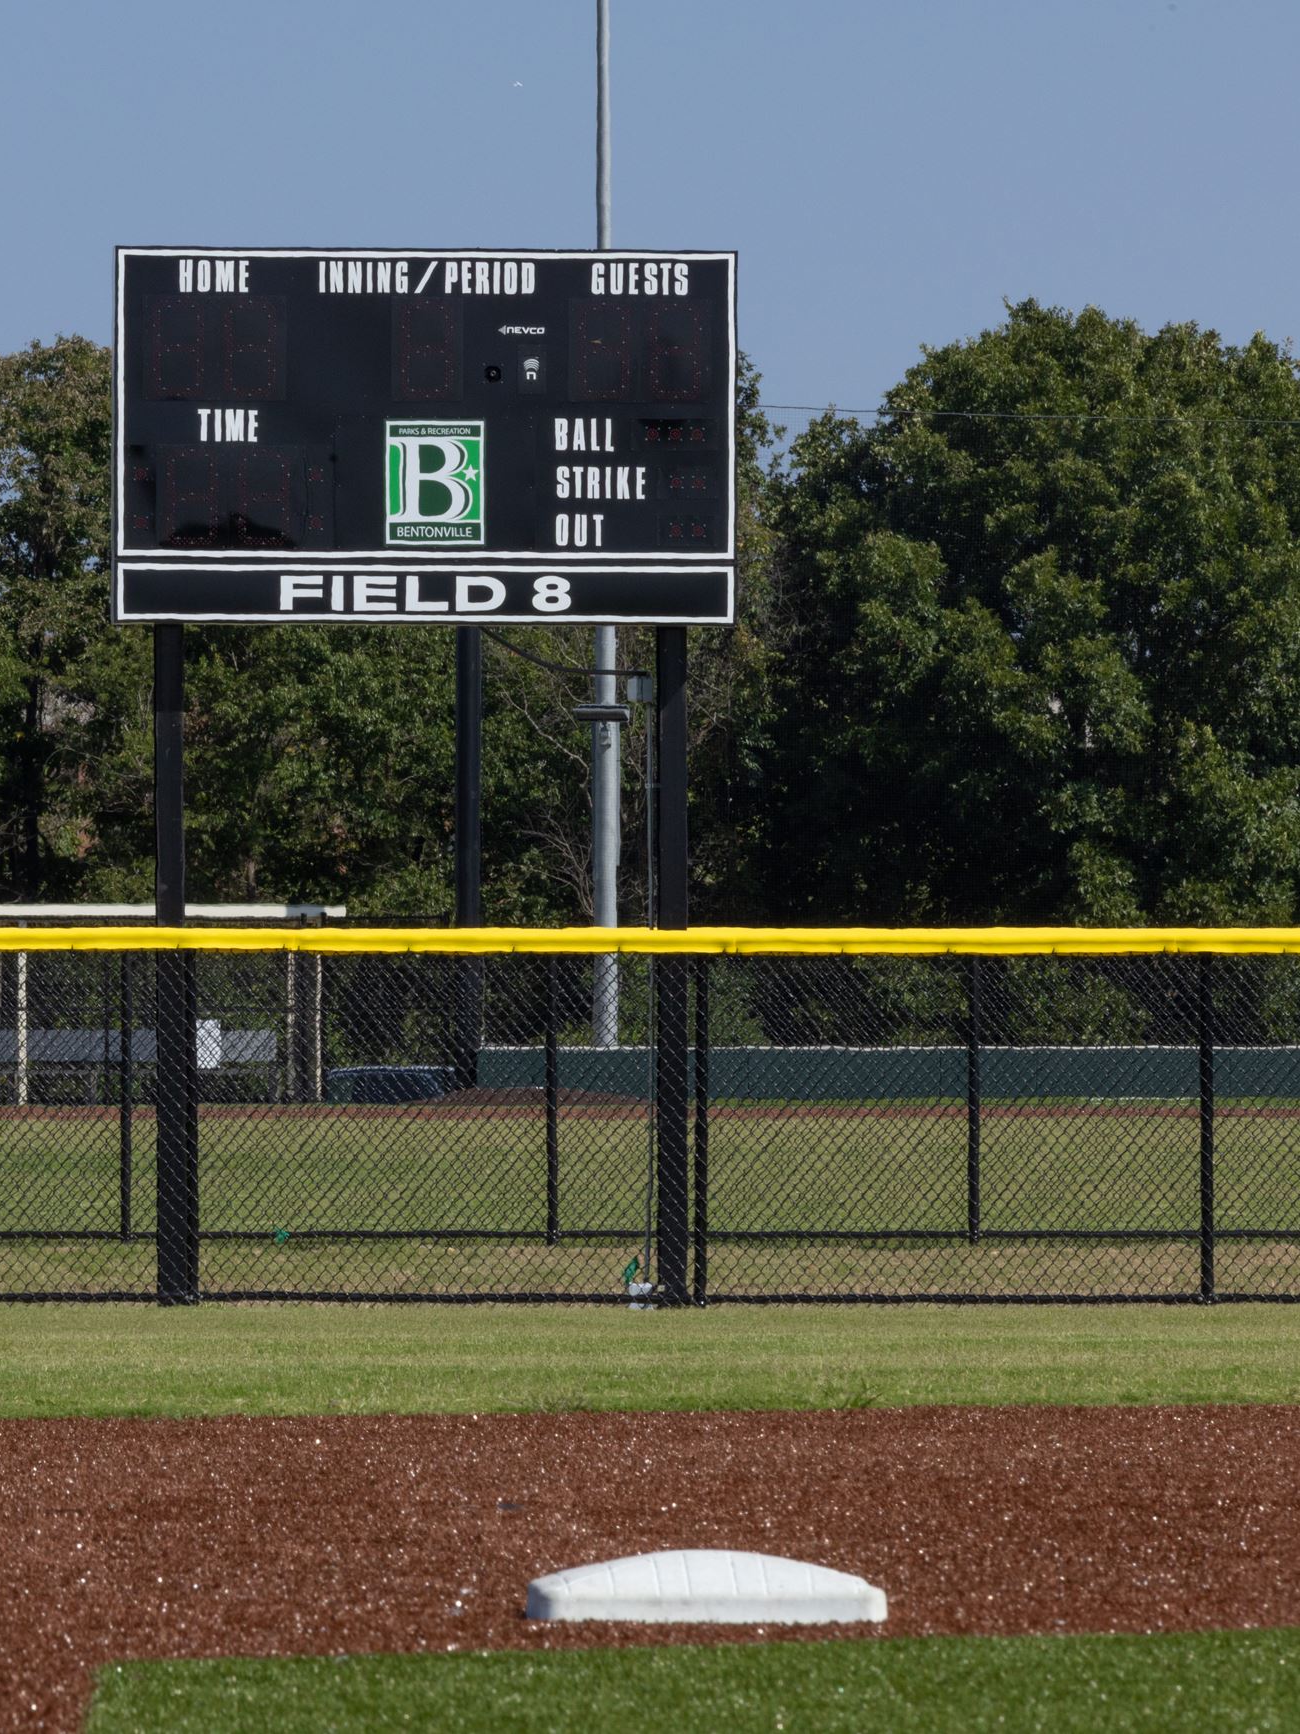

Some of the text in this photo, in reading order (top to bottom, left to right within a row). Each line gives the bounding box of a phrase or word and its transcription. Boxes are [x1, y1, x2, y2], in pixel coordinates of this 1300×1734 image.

[178, 260, 250, 294] HOME
[318, 261, 537, 296] INNING/PERIOD
[591, 263, 690, 297] GUESTS
[198, 408, 259, 443] TIME
[398, 427, 471, 436] PARKS & RECREATION
[554, 417, 615, 453] BALL
[389, 440, 473, 521] B
[556, 465, 646, 501] STRIKE
[396, 525, 473, 538] BENTONVILLE
[555, 513, 604, 548] OUT
[279, 575, 573, 612] FIELD 8
